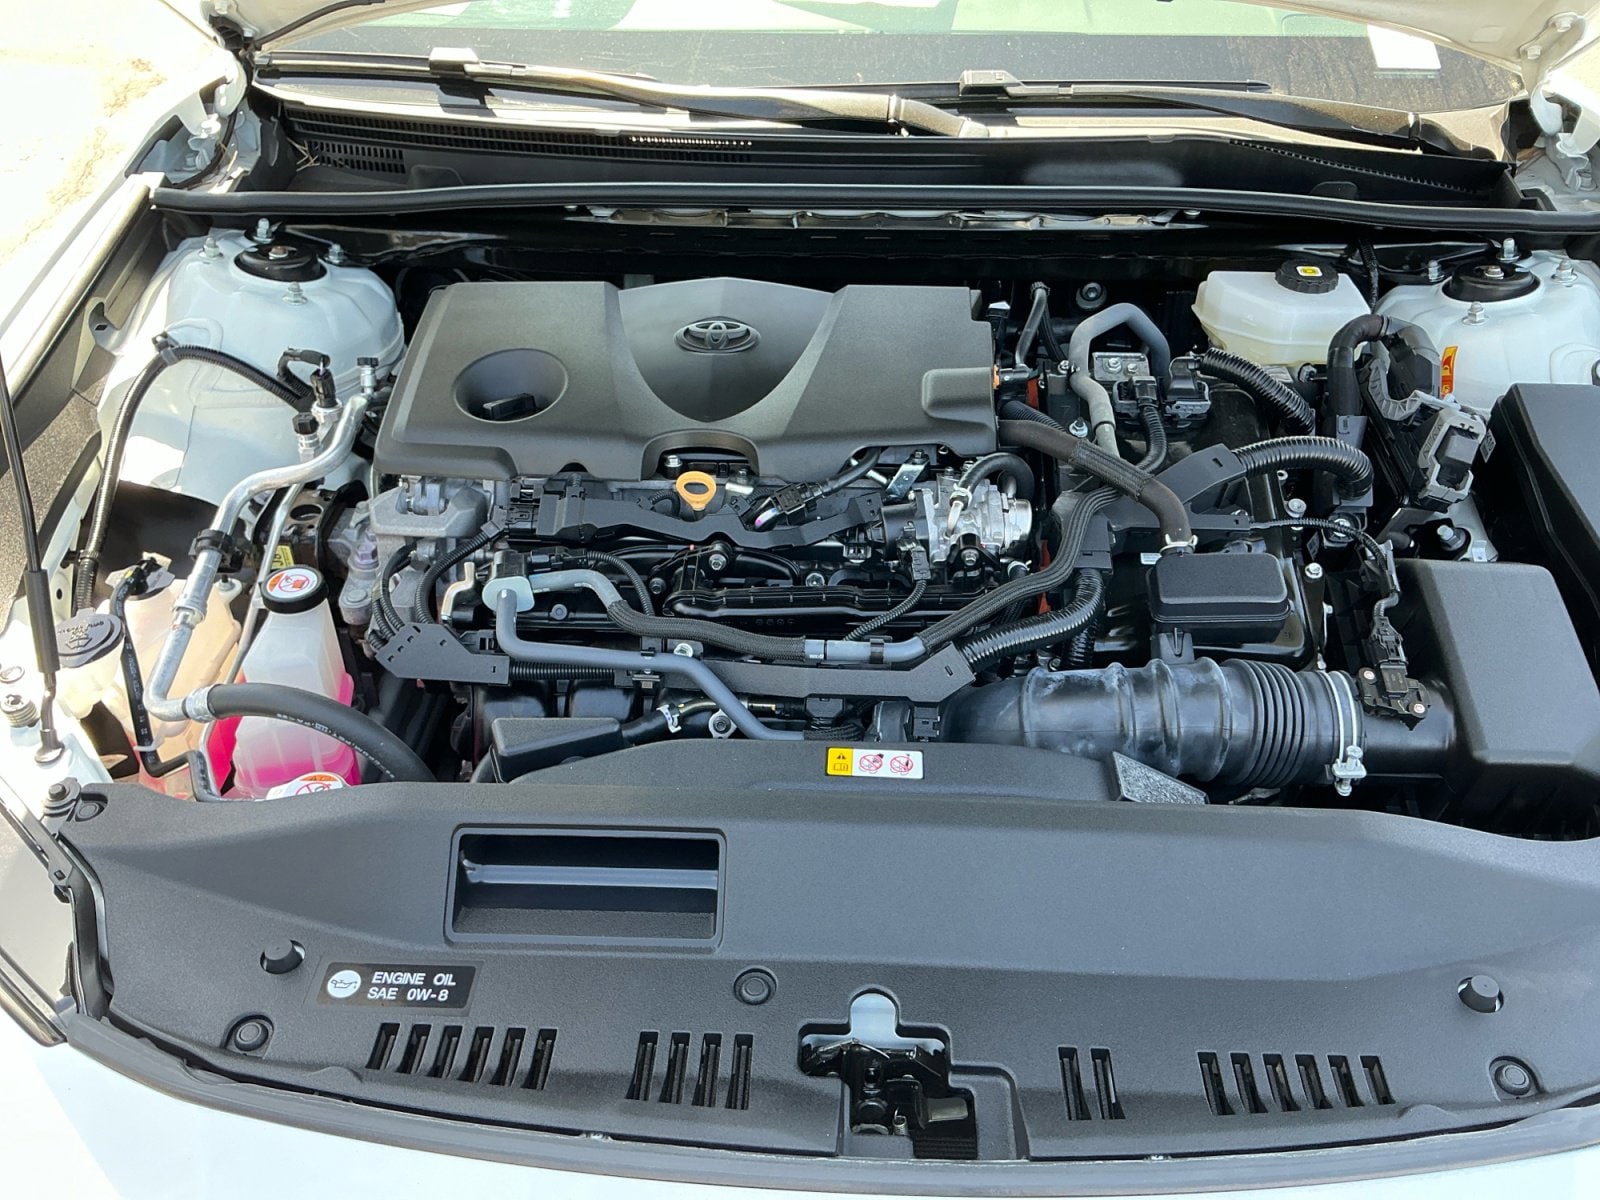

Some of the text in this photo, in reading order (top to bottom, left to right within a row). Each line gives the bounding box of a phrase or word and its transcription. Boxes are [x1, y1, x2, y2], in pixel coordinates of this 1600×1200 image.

[371, 971, 457, 986] ENGINE OIL
[367, 987, 449, 1001] SAE 0W-8
